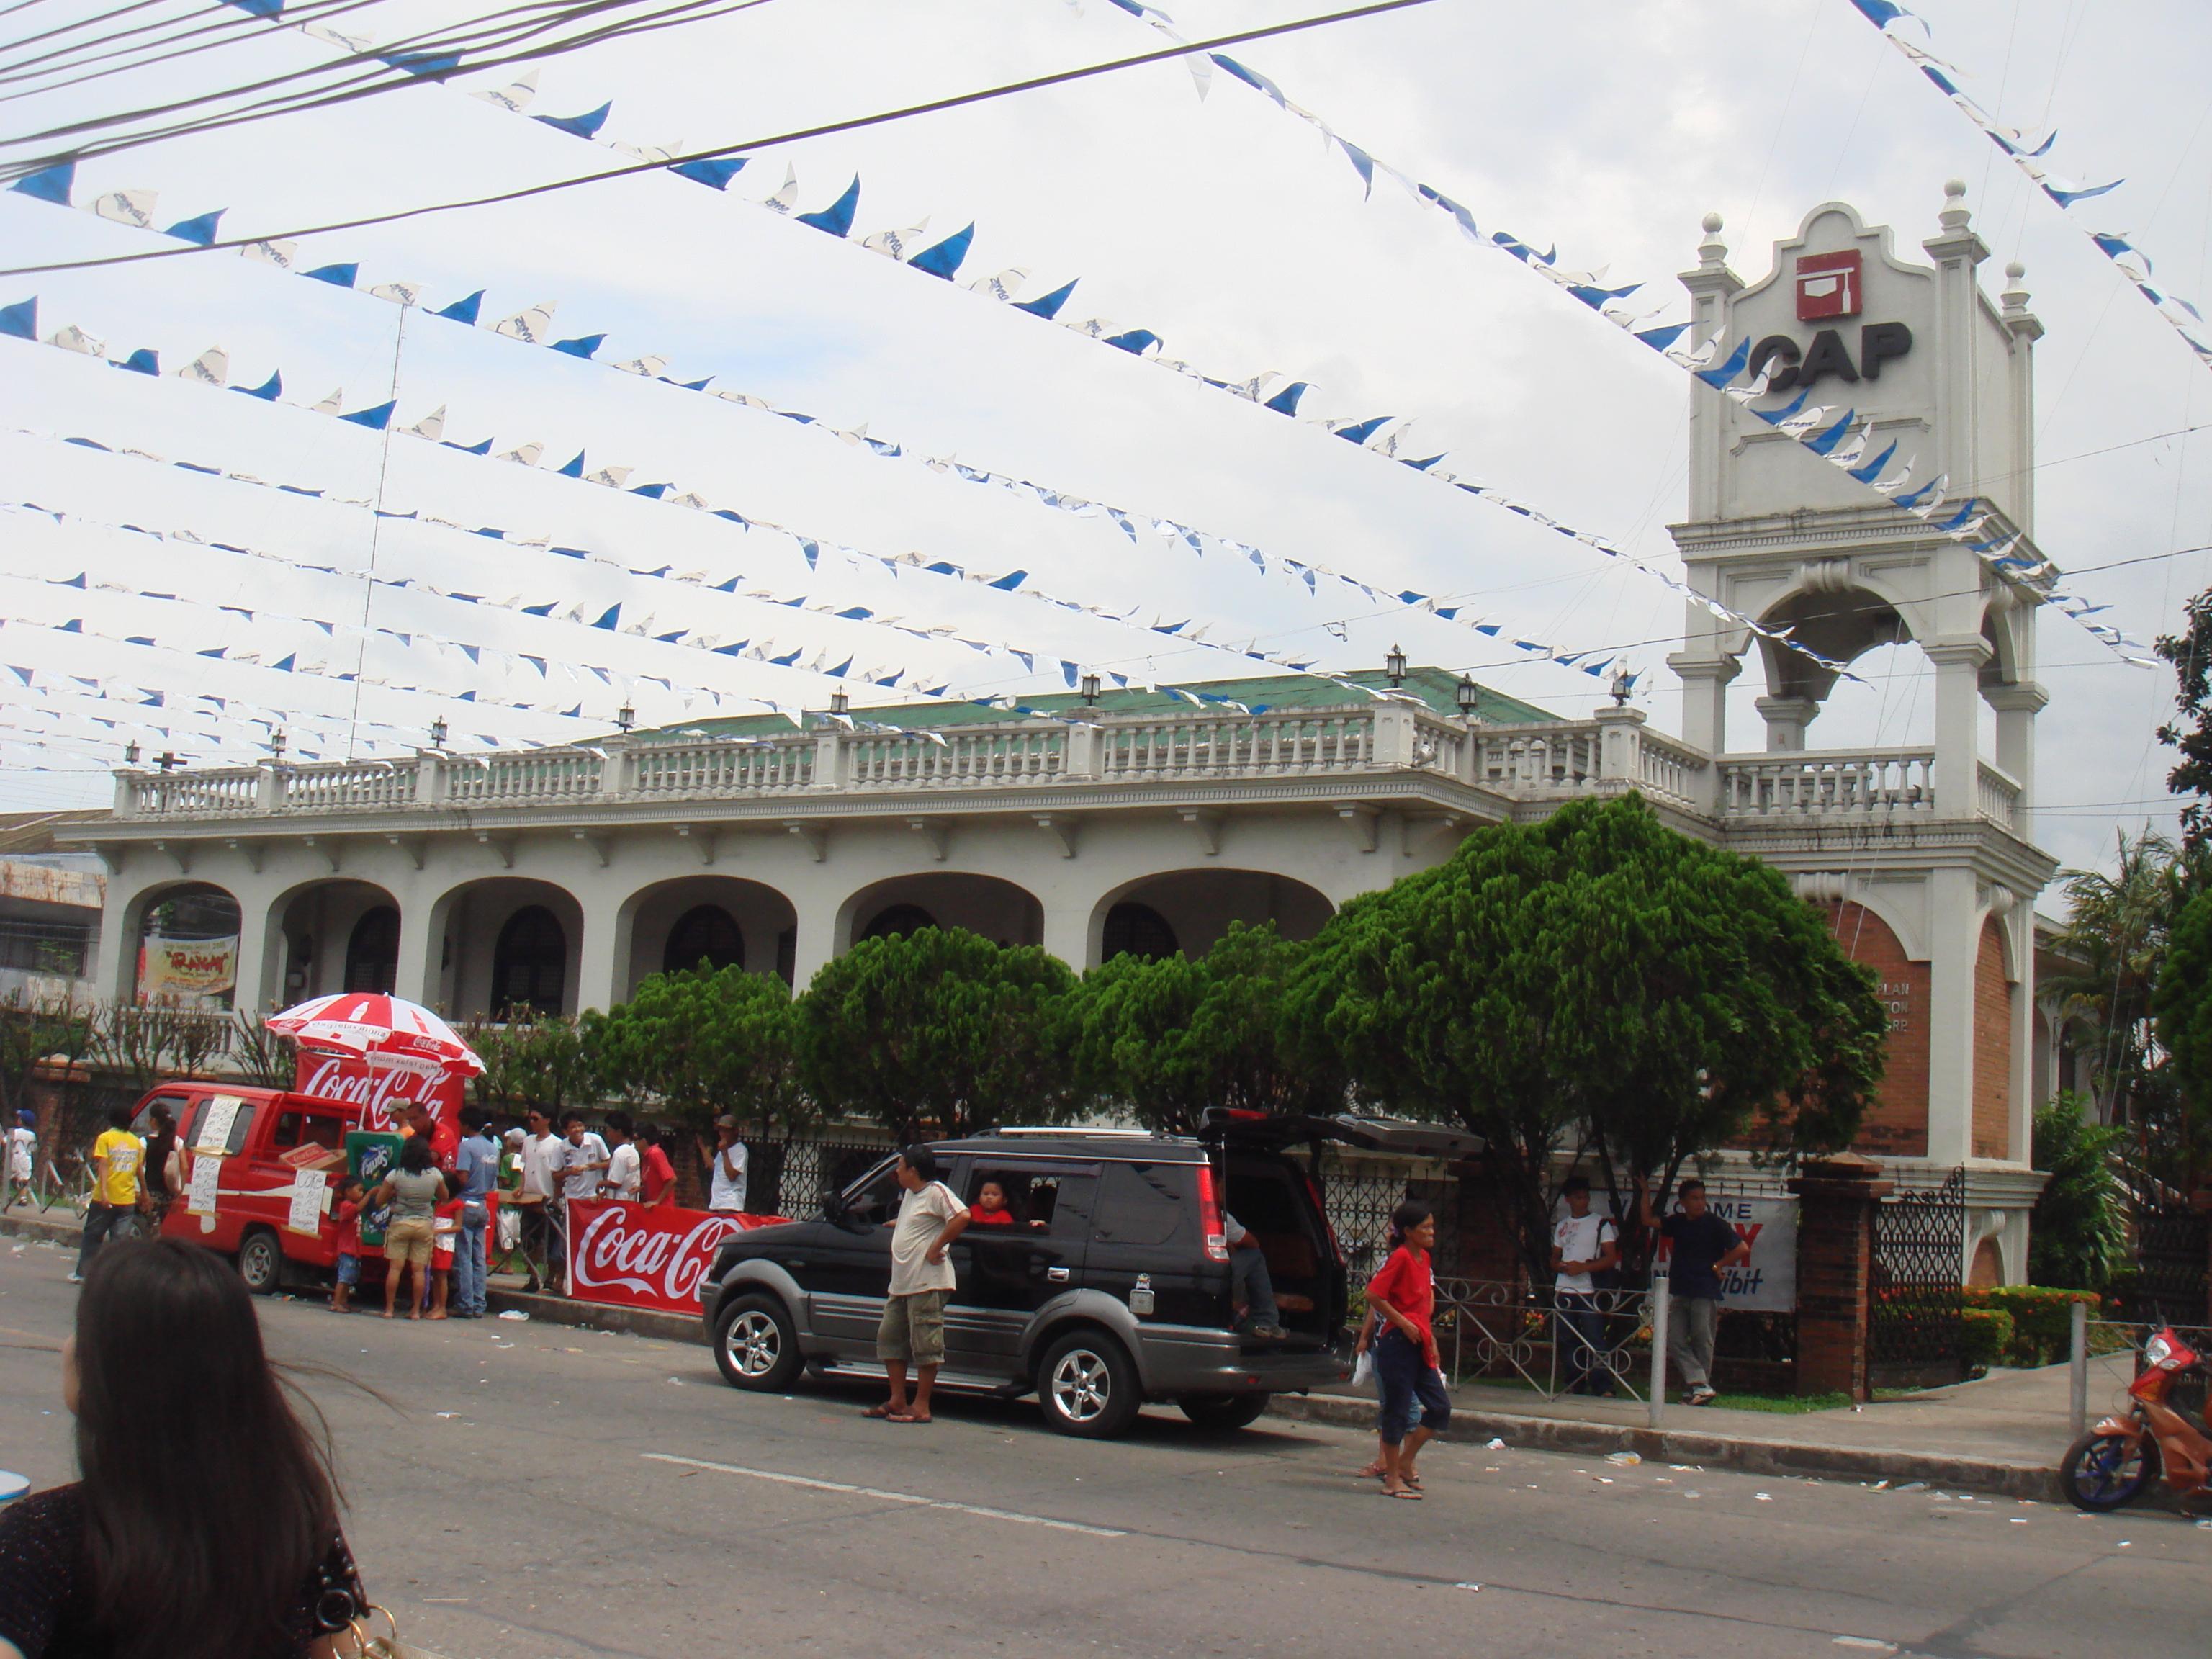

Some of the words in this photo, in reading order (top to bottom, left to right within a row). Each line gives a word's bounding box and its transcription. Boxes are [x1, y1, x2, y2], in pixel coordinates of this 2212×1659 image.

[1748, 322, 1913, 392] CAP
[1876, 982, 1909, 996] PLAN
[413, 1035, 441, 1052] Coca-Cola
[297, 1172, 323, 1190] Coke
